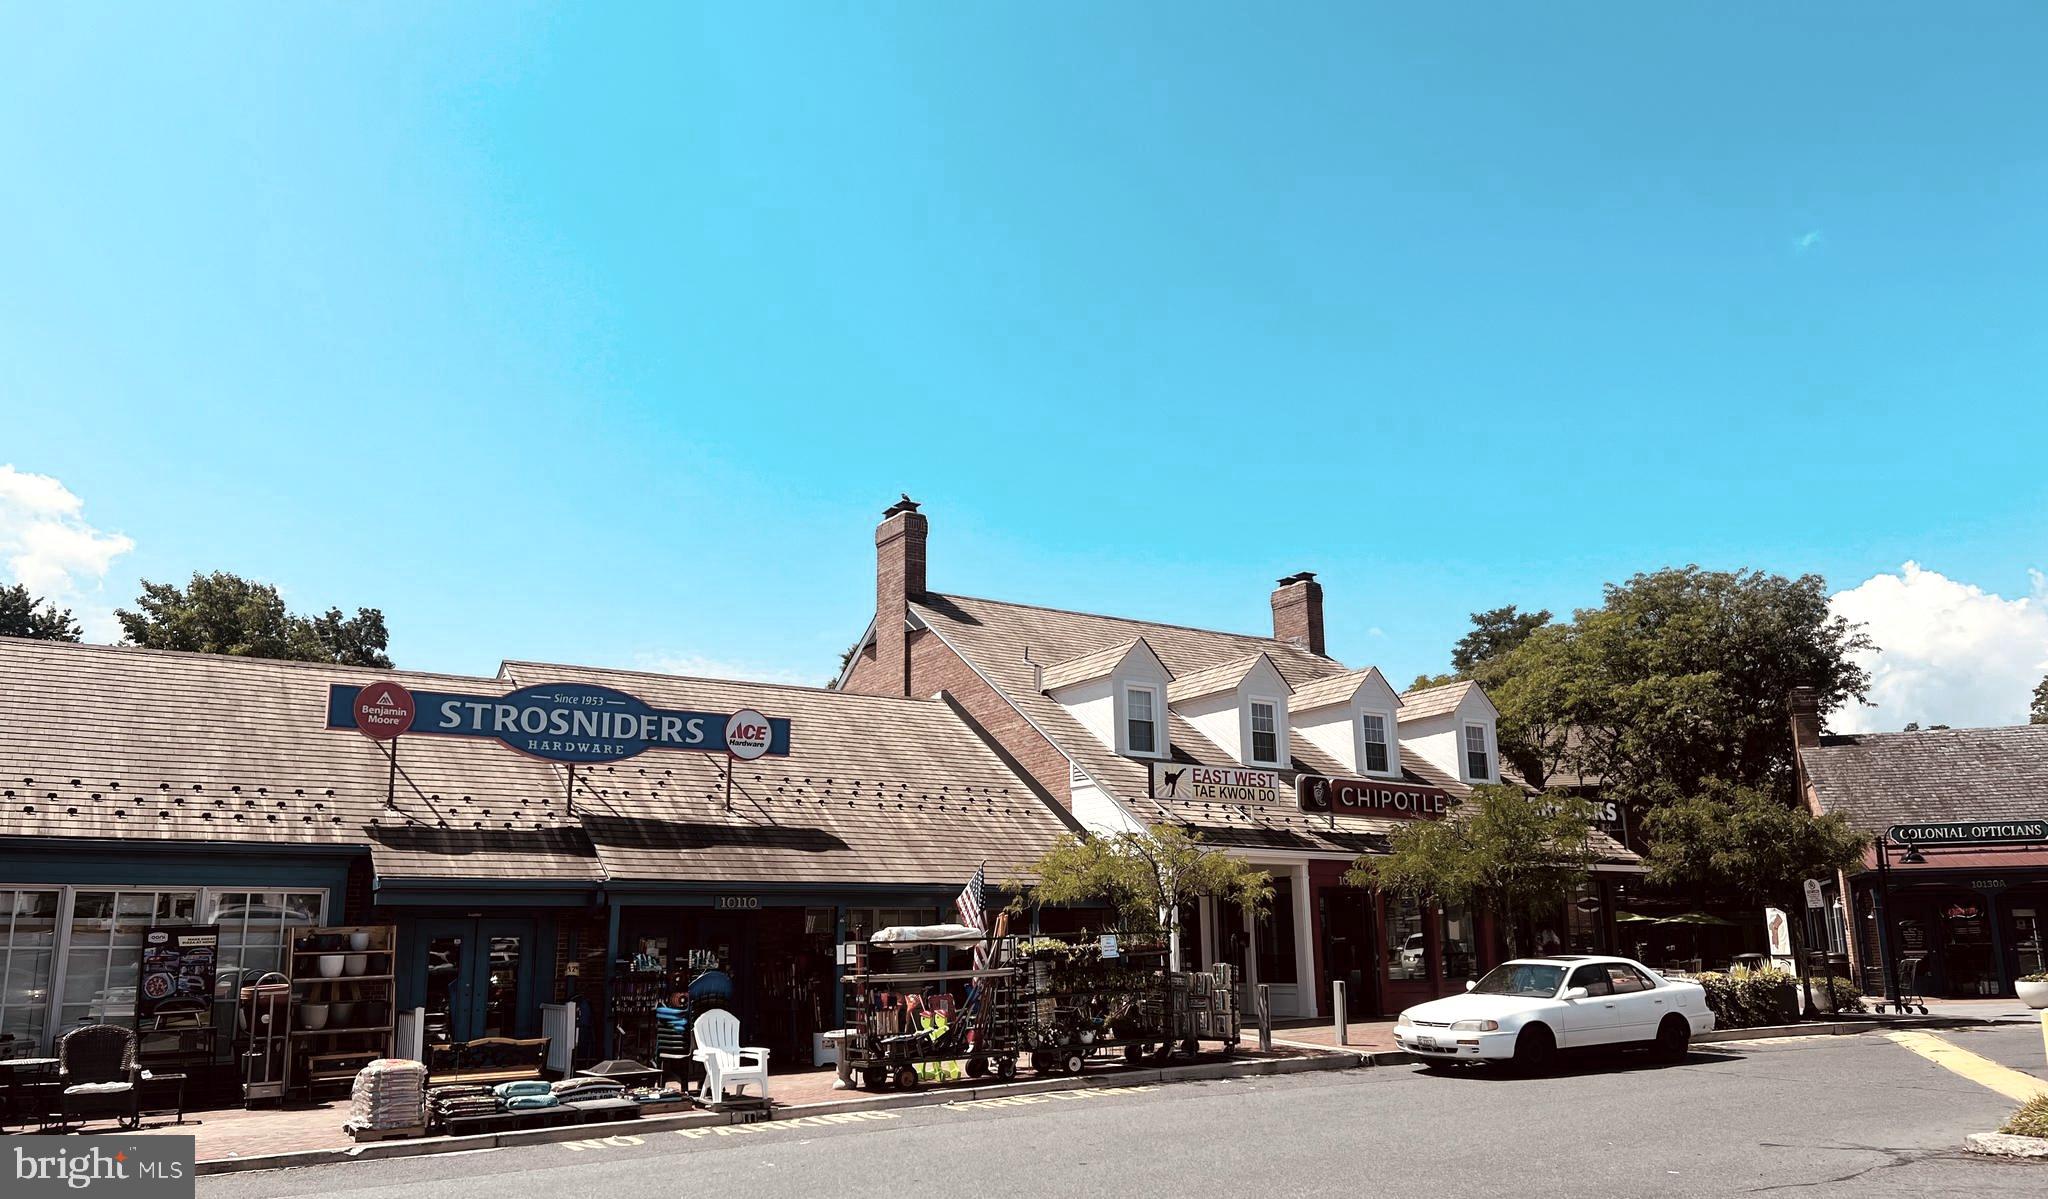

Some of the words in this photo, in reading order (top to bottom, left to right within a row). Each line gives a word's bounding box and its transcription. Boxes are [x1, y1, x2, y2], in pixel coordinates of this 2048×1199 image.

[554, 693, 579, 704] Since
[581, 695, 604, 706] 1953
[362, 705, 407, 716] Benjamin
[368, 715, 399, 725] Moore
[439, 700, 704, 744] STROSNIDERS
[730, 722, 767, 740] ACE
[528, 740, 624, 754] HARDWARE
[729, 739, 765, 748] Hardware
[1192, 768, 1231, 784] EAST
[1234, 770, 1275, 788] WEST
[1193, 784, 1216, 798] TAE
[1219, 786, 1255, 800] KWON
[1258, 789, 1276, 802] DO
[1341, 787, 1446, 813] CHIPOTLE
[1900, 827, 1967, 840] COLONIAL
[1971, 824, 2042, 838] OPTICIANS
[1971, 880, 2007, 889] 10130A
[721, 897, 758, 908] 10110
[562, 1134, 645, 1152] NO
[675, 1110, 901, 1139] PARKING
